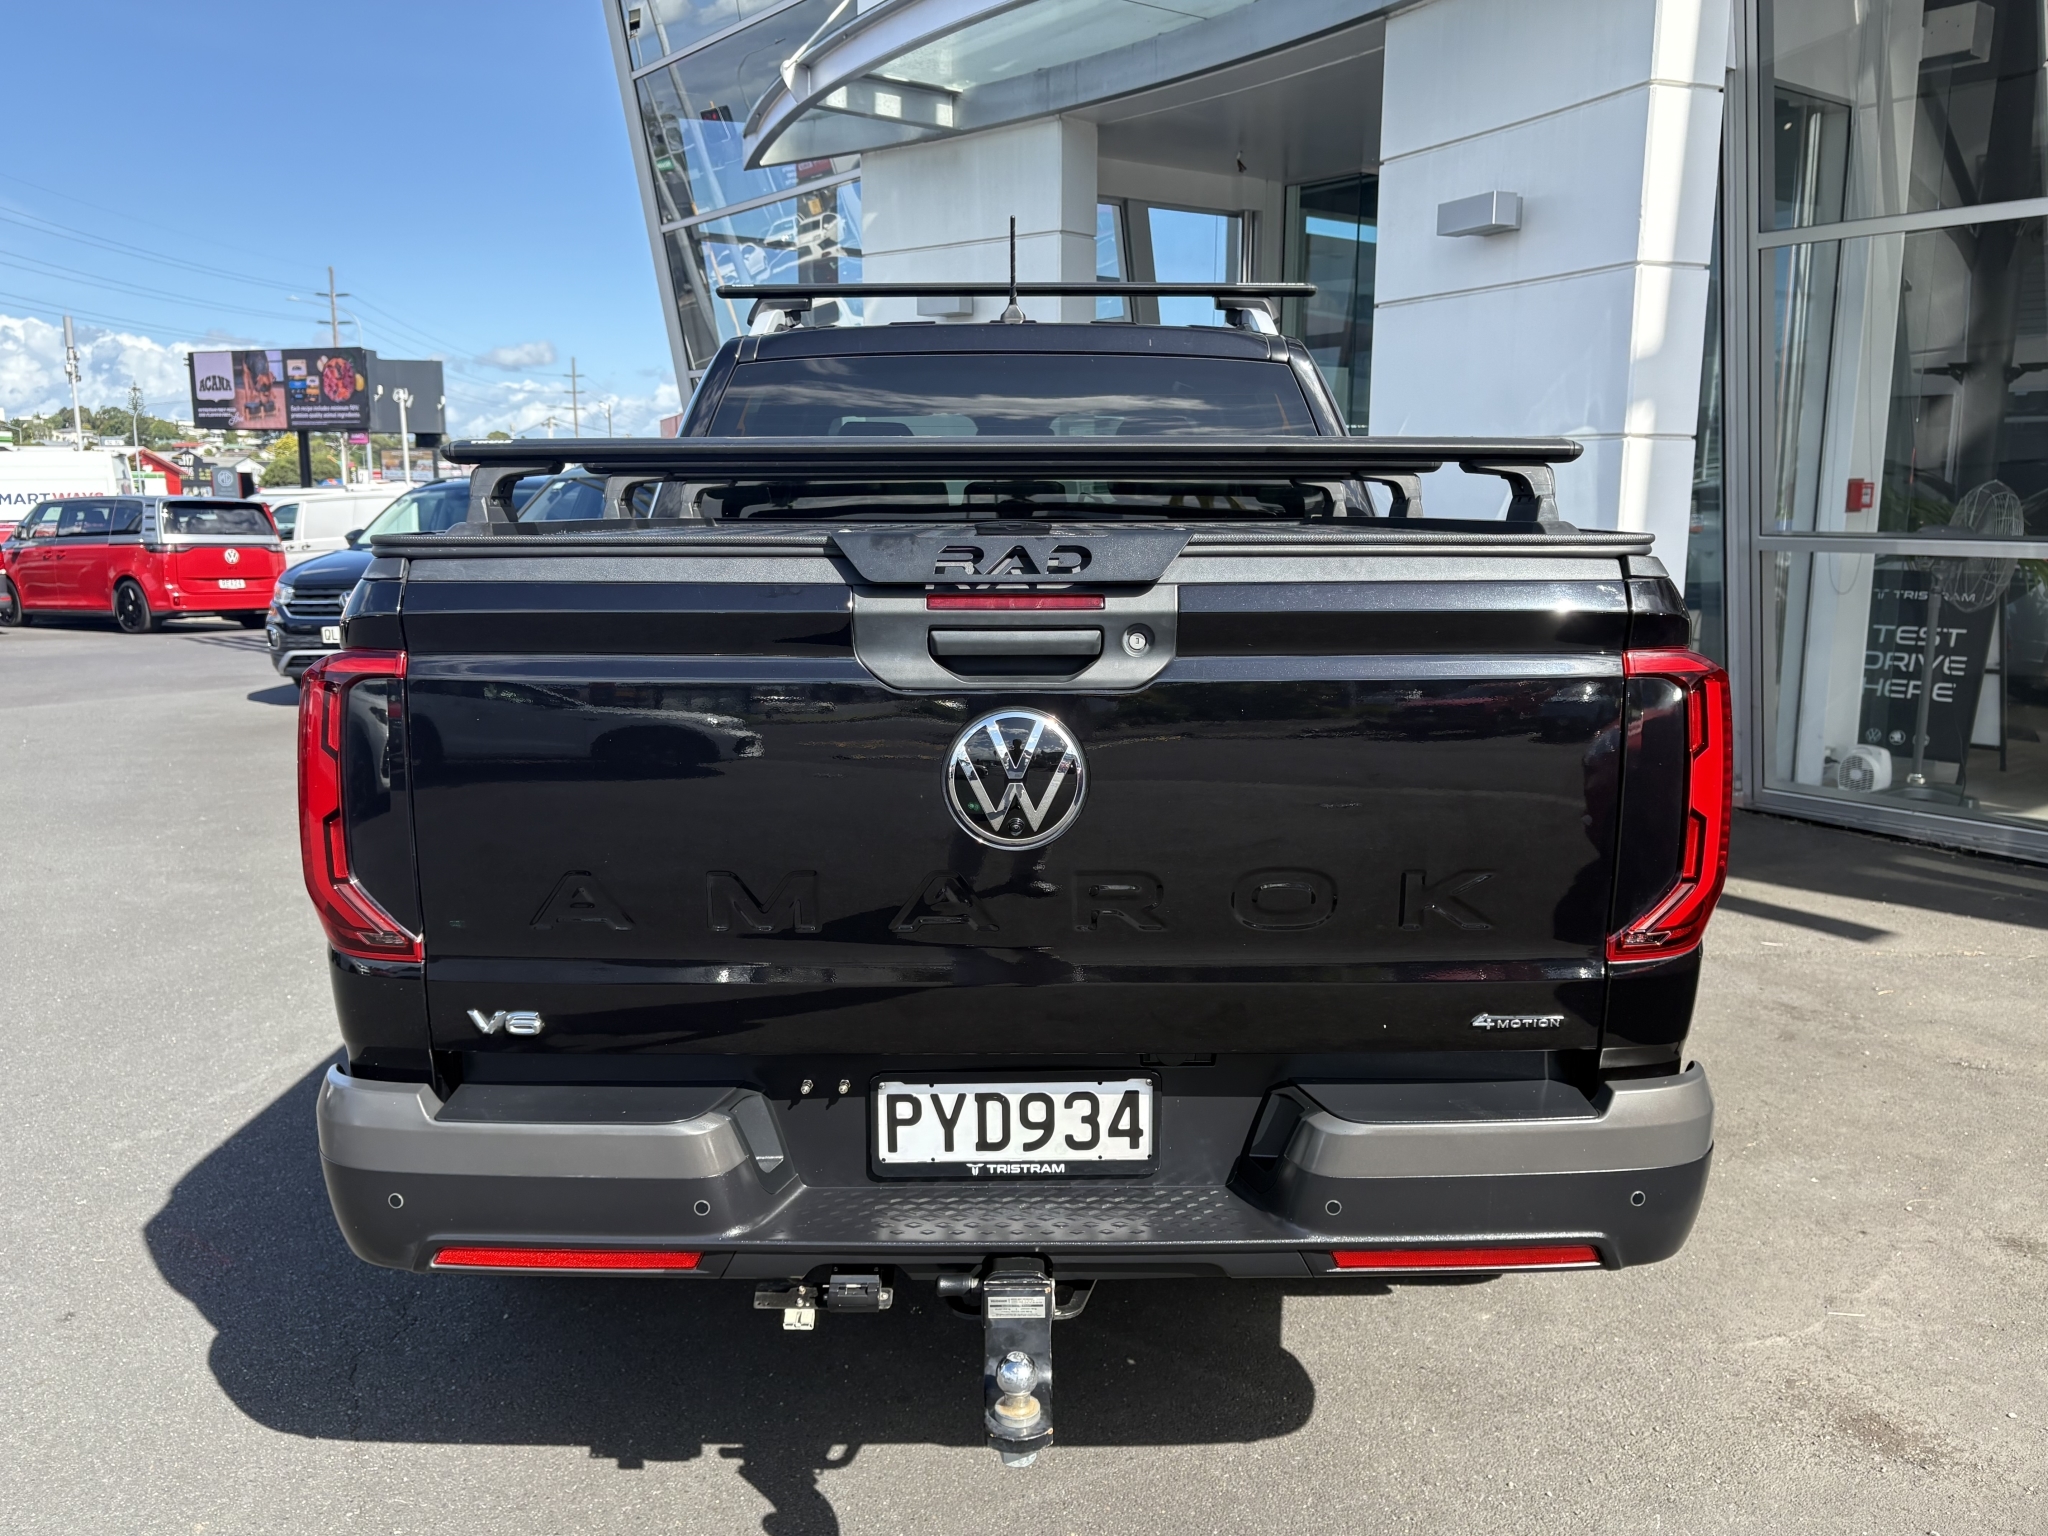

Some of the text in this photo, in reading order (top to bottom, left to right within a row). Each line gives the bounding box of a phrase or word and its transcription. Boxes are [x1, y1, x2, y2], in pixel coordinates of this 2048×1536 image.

[199, 374, 232, 391] ACANA
[932, 544, 1093, 576] RAD
[1873, 624, 1967, 647] TEST
[1864, 651, 1968, 676] DRIVE
[530, 869, 1495, 934] AMAROK
[466, 1009, 543, 1036] V6
[886, 1090, 1144, 1154] PYD934
[987, 1164, 1065, 1174] TRISTRAM
